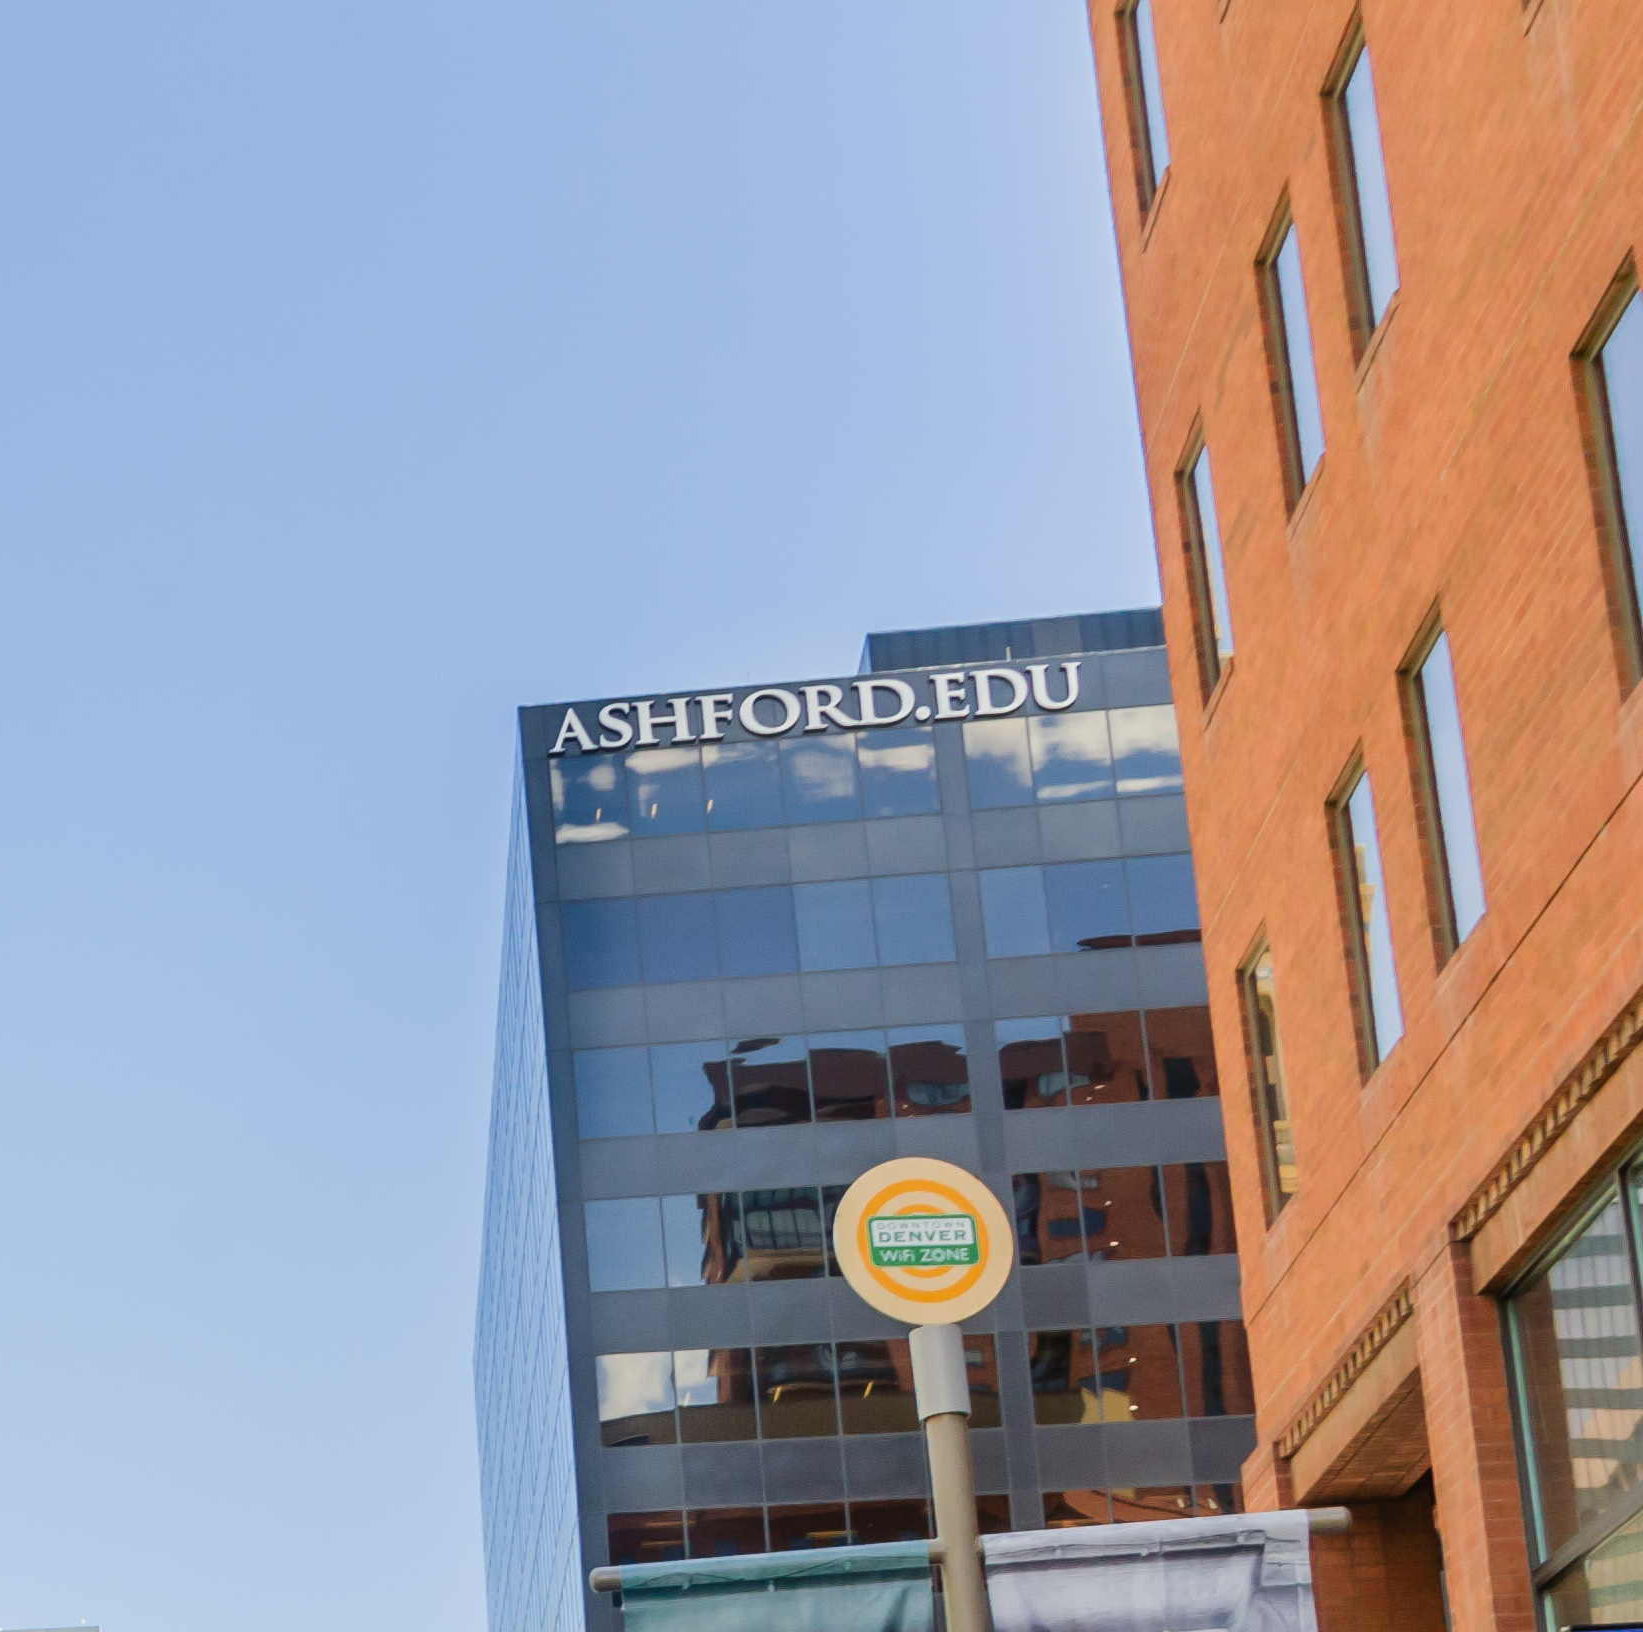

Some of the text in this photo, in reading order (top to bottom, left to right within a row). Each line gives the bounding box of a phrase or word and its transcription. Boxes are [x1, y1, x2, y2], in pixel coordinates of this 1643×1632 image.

[548, 661, 1083, 755] ASHFORD.EDU
[877, 1221, 965, 1231] DOWNTOWN
[878, 1230, 967, 1244] DENVER
[879, 1247, 971, 1263] WiFi ZONE
